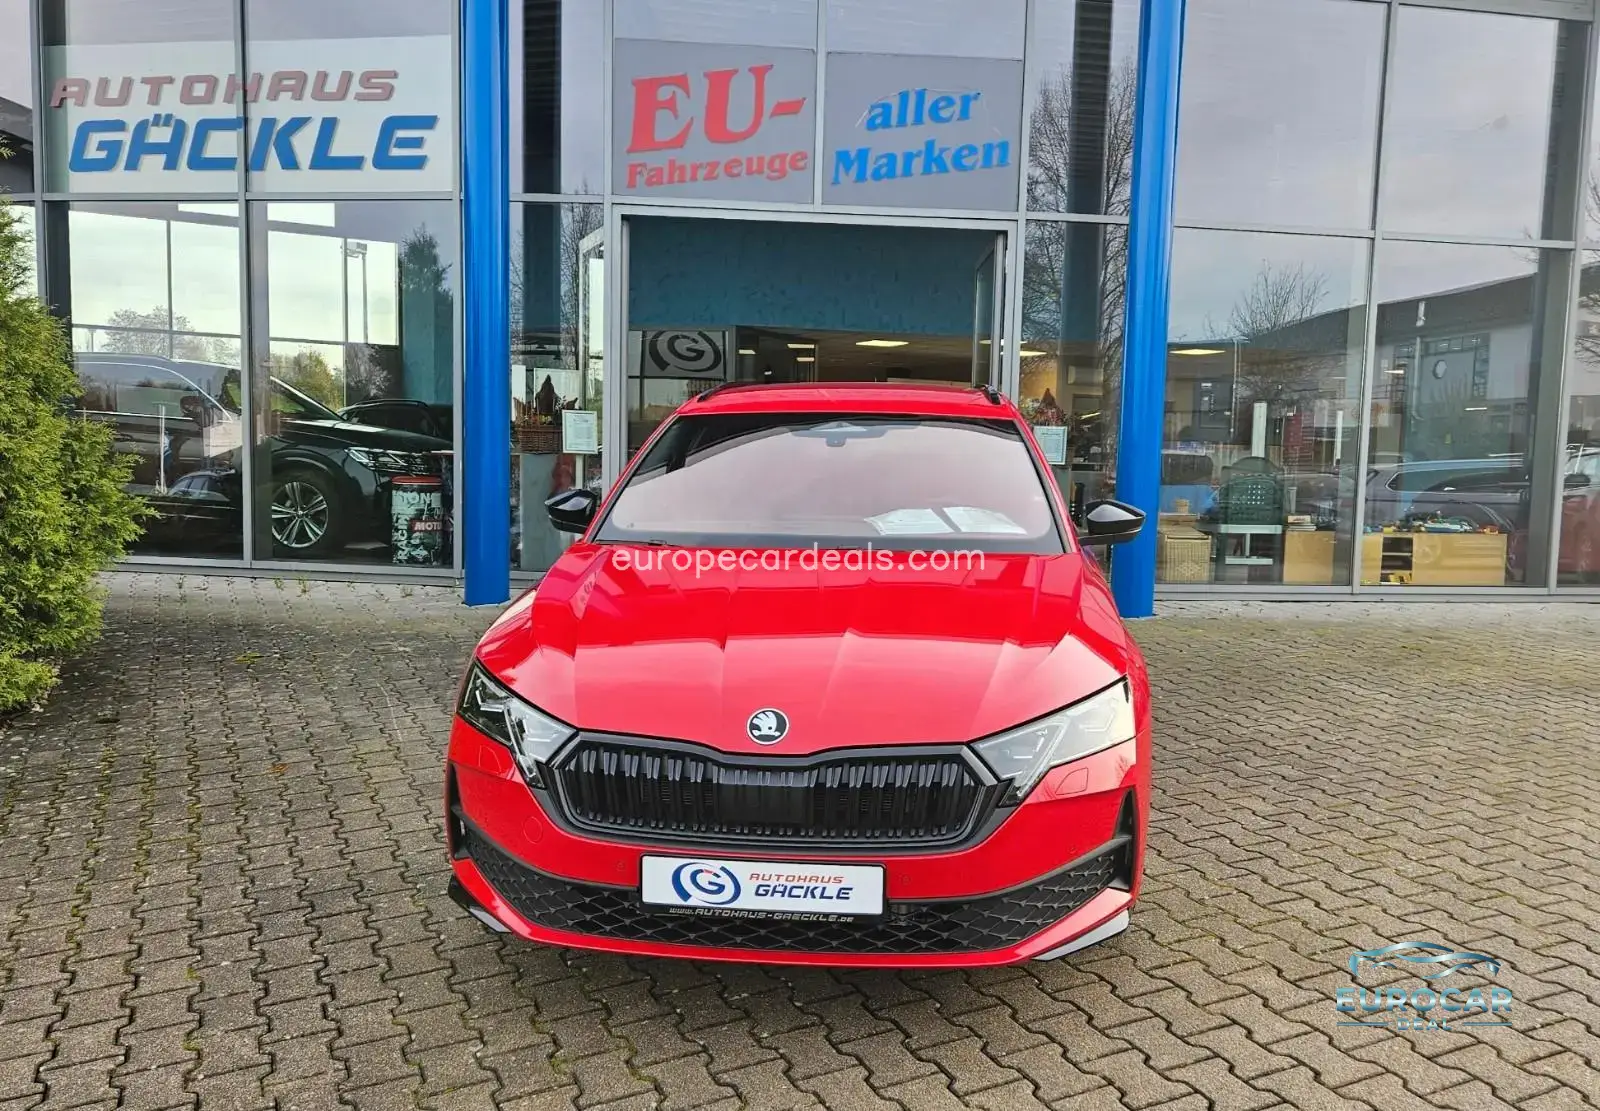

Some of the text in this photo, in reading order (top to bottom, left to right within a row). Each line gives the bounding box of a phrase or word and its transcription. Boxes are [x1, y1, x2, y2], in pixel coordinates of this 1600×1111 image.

[50, 70, 398, 108] AUTOHAUS
[627, 64, 807, 154] EU-
[865, 88, 981, 132] aller
[69, 113, 438, 172] GÄCKLE
[831, 138, 1010, 186] Marken
[626, 149, 809, 189] Fahrzeuge
[749, 873, 844, 884] AUTOHAUS
[754, 884, 853, 900] GÄCKLE
